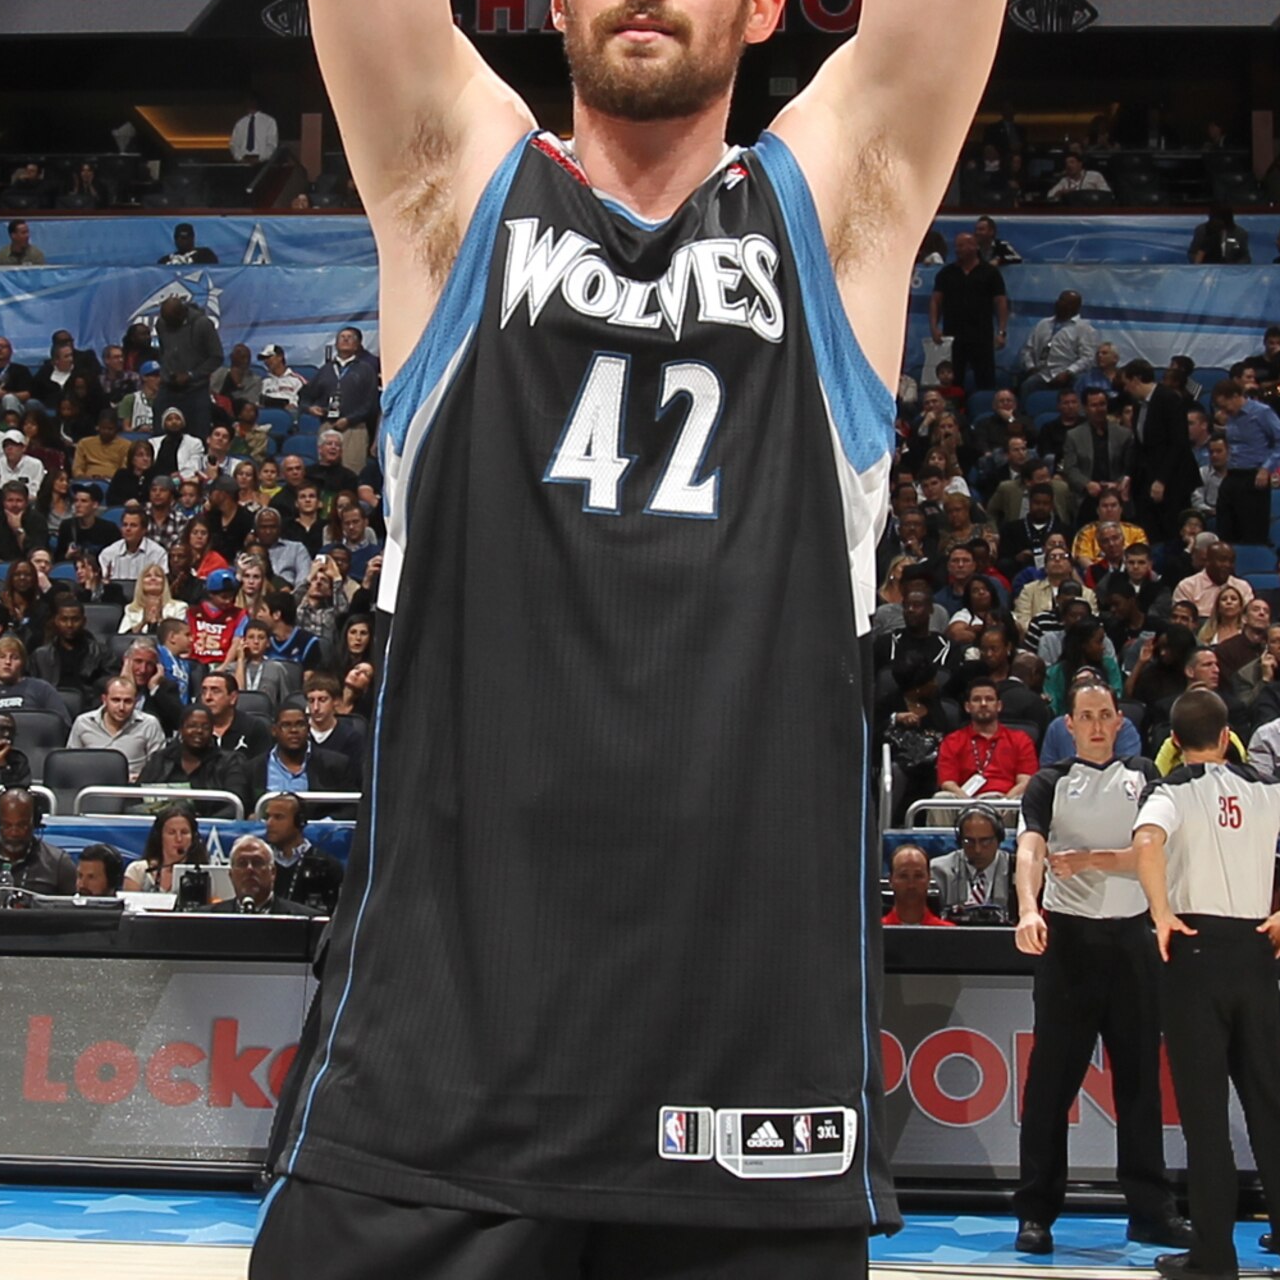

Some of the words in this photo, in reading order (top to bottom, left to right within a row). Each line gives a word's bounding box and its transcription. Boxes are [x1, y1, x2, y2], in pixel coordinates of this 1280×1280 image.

[500, 216, 785, 343] WOLVES
[541, 350, 726, 519] 42
[196, 620, 227, 635] WEST
[1218, 795, 1242, 830] 35
[746, 1138, 784, 1149] adidas
[816, 1125, 841, 1139] 3XL
